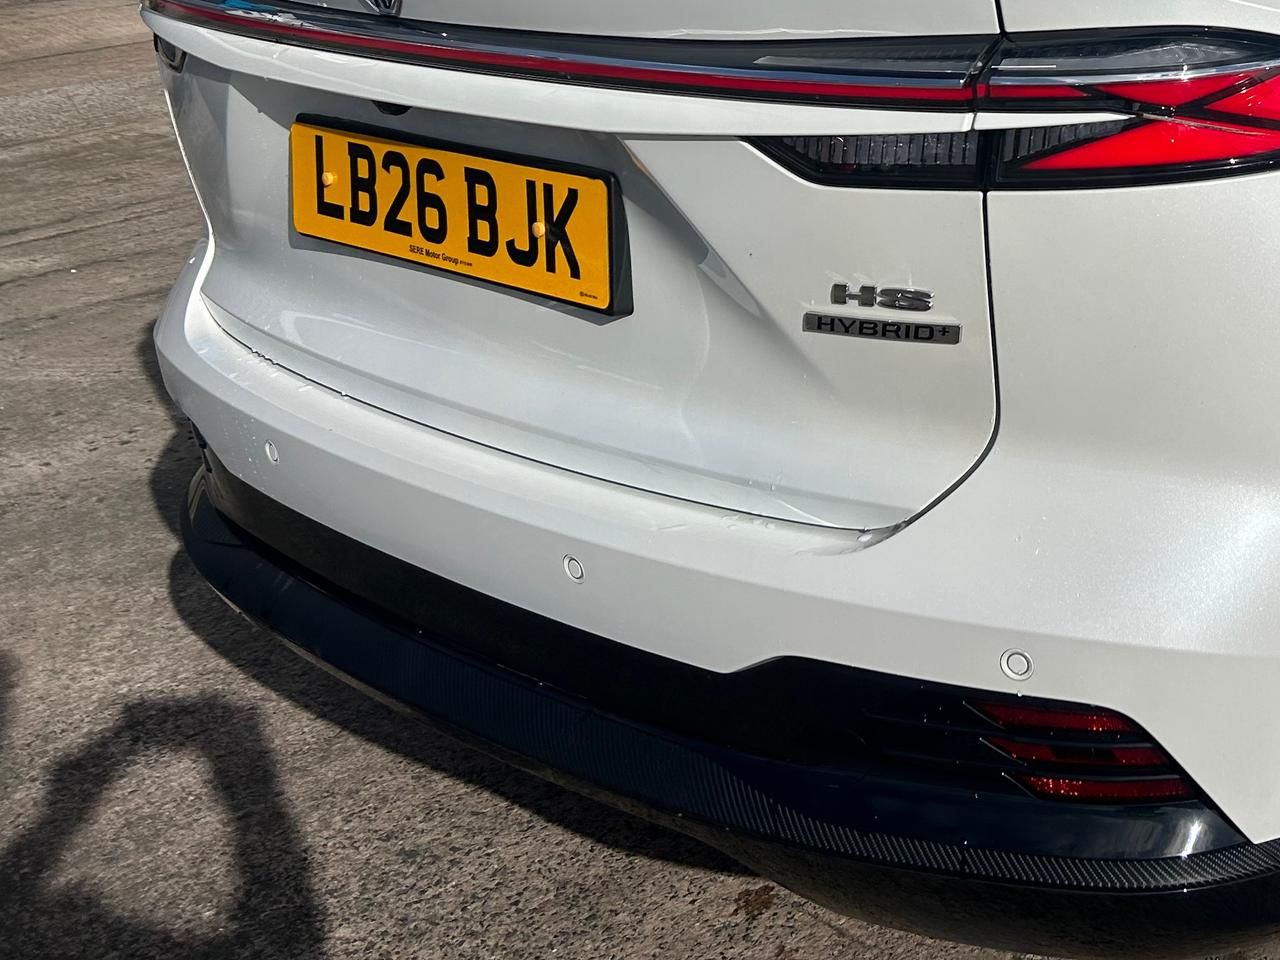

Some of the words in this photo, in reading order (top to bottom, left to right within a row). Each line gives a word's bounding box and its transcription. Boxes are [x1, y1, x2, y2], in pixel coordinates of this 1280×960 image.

[314, 135, 447, 245] LB26
[464, 166, 581, 280] BJK
[409, 244, 425, 256] SERE
[425, 248, 441, 259] Motor
[441, 253, 459, 266] Group
[816, 317, 950, 341] HYBRID+
